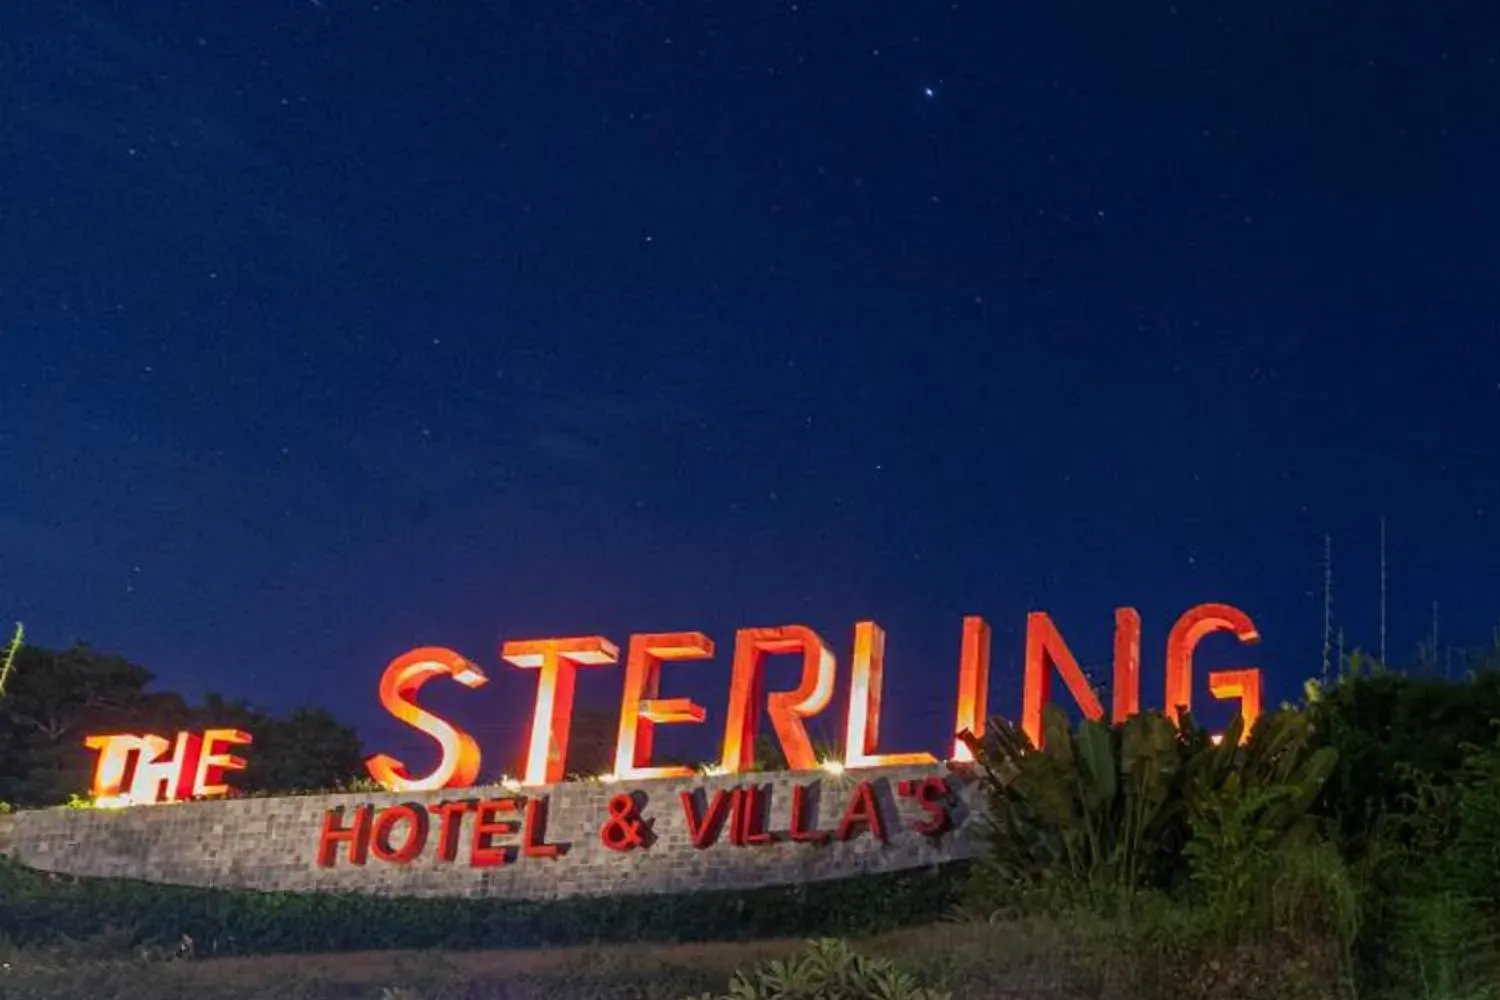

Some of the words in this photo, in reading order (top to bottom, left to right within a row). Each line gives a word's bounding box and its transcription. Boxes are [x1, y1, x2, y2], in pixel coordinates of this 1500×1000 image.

[84, 729, 253, 806] THE
[365, 603, 1262, 792] STERLING
[316, 796, 564, 867] HOTEL
[601, 793, 642, 852] &
[679, 775, 953, 849] VILLA'S
